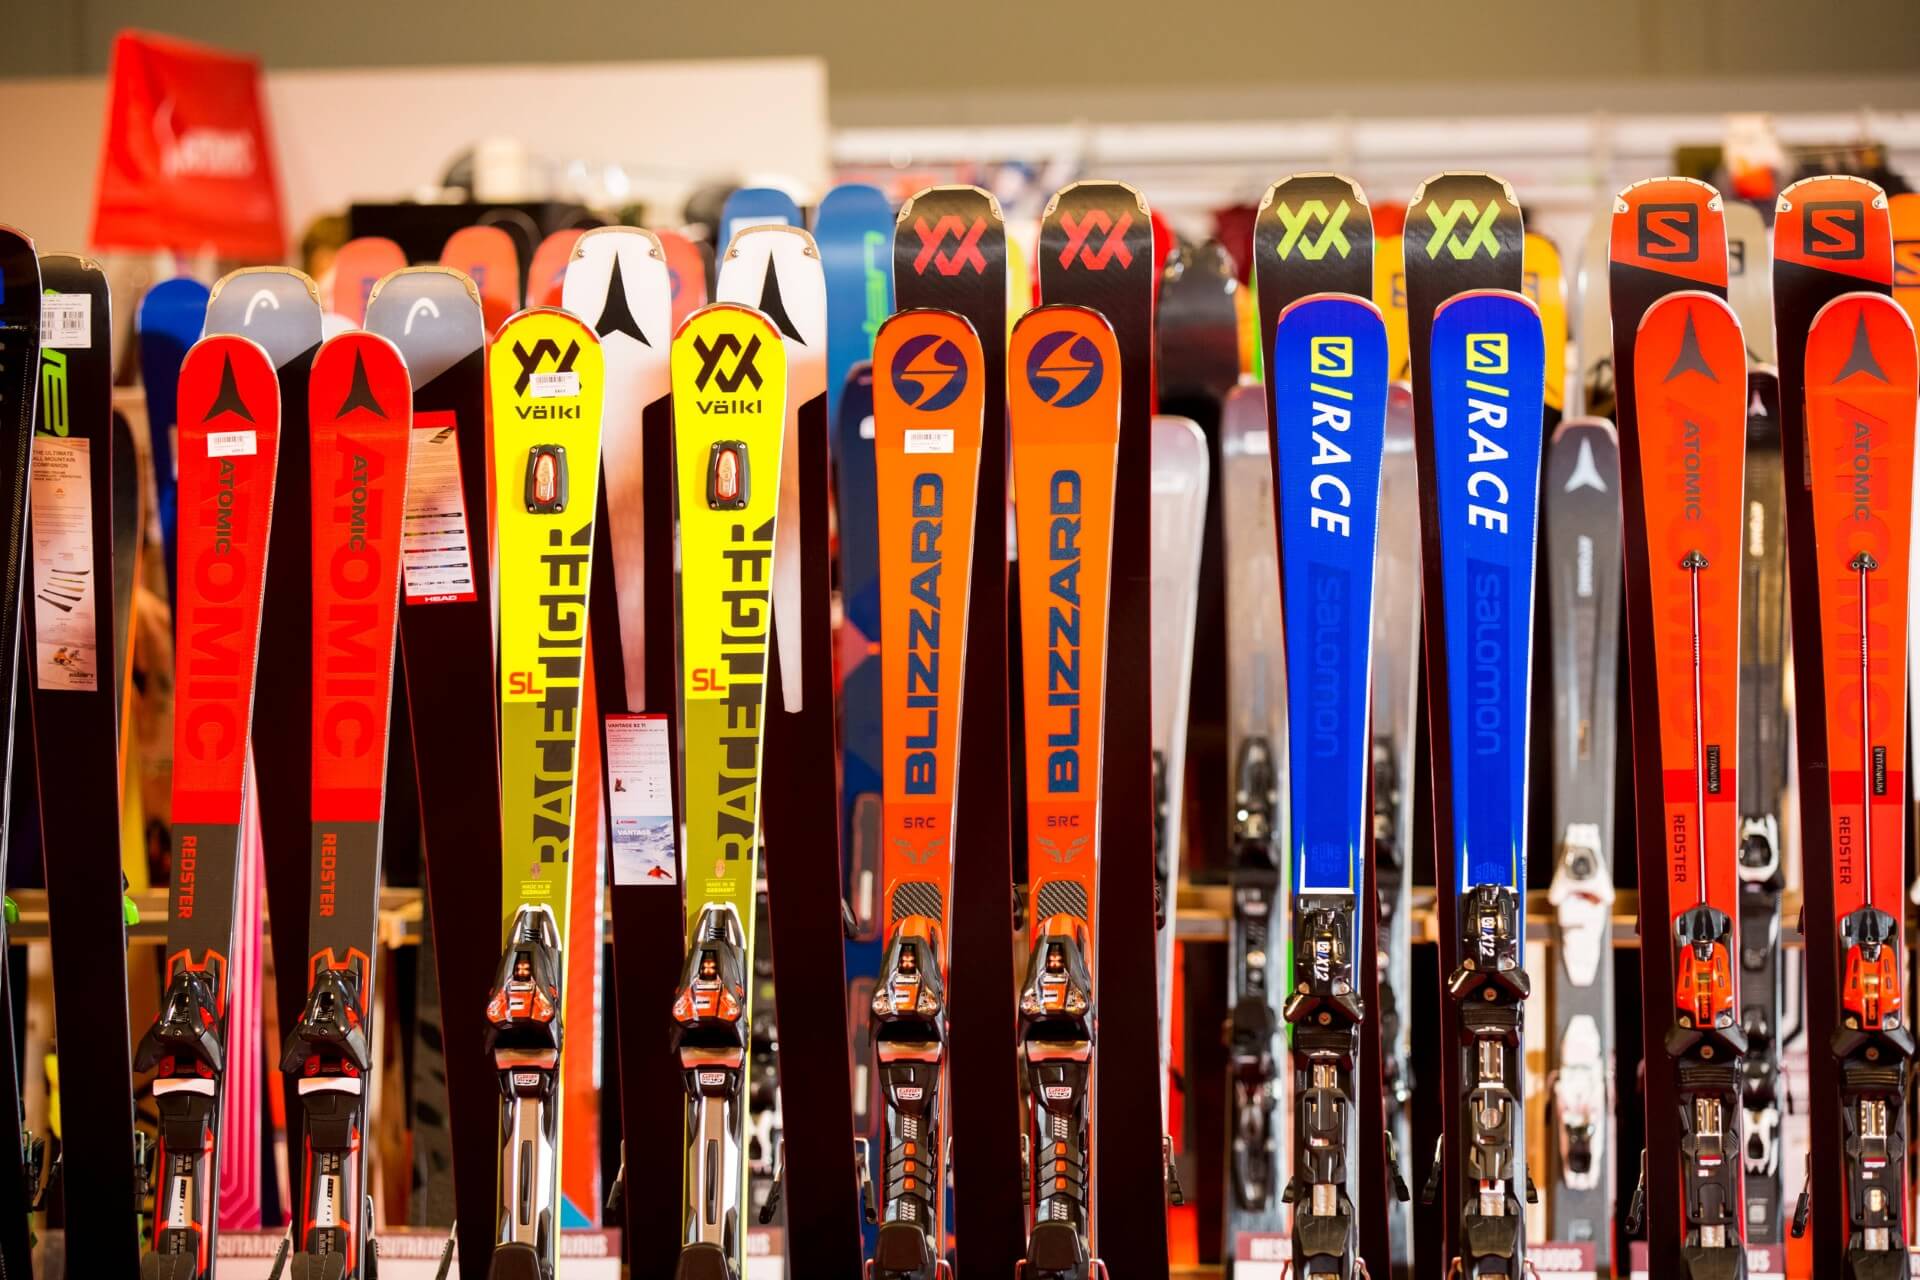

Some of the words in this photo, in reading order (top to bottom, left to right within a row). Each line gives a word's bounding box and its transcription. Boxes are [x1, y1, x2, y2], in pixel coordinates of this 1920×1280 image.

[514, 405, 580, 419] Völkl
[695, 400, 762, 415] Völkl
[215, 457, 235, 555] ATOMIC
[349, 455, 368, 552] ATOMIC
[1683, 419, 1702, 520] ATOMIC
[1853, 421, 1871, 521] ATOMIC
[904, 472, 944, 795] BLIZZARD
[1047, 469, 1081, 793] BLIZZARD
[1313, 576, 1342, 758] salomon
[1474, 573, 1502, 755] salomon
[508, 671, 543, 695] SL
[532, 519, 592, 863] RACETIGER
[691, 668, 726, 692] SL
[717, 516, 775, 860] RACETIGER
[1709, 751, 1718, 792] TITANIUM
[1874, 752, 1884, 793] TITANIUM
[903, 816, 936, 829] SRC
[1047, 815, 1080, 828] SRC
[1673, 815, 1686, 882] REDSTER
[1839, 816, 1852, 885] REDSTER
[177, 835, 198, 919] REDSTER
[319, 833, 337, 917] REDSTER
